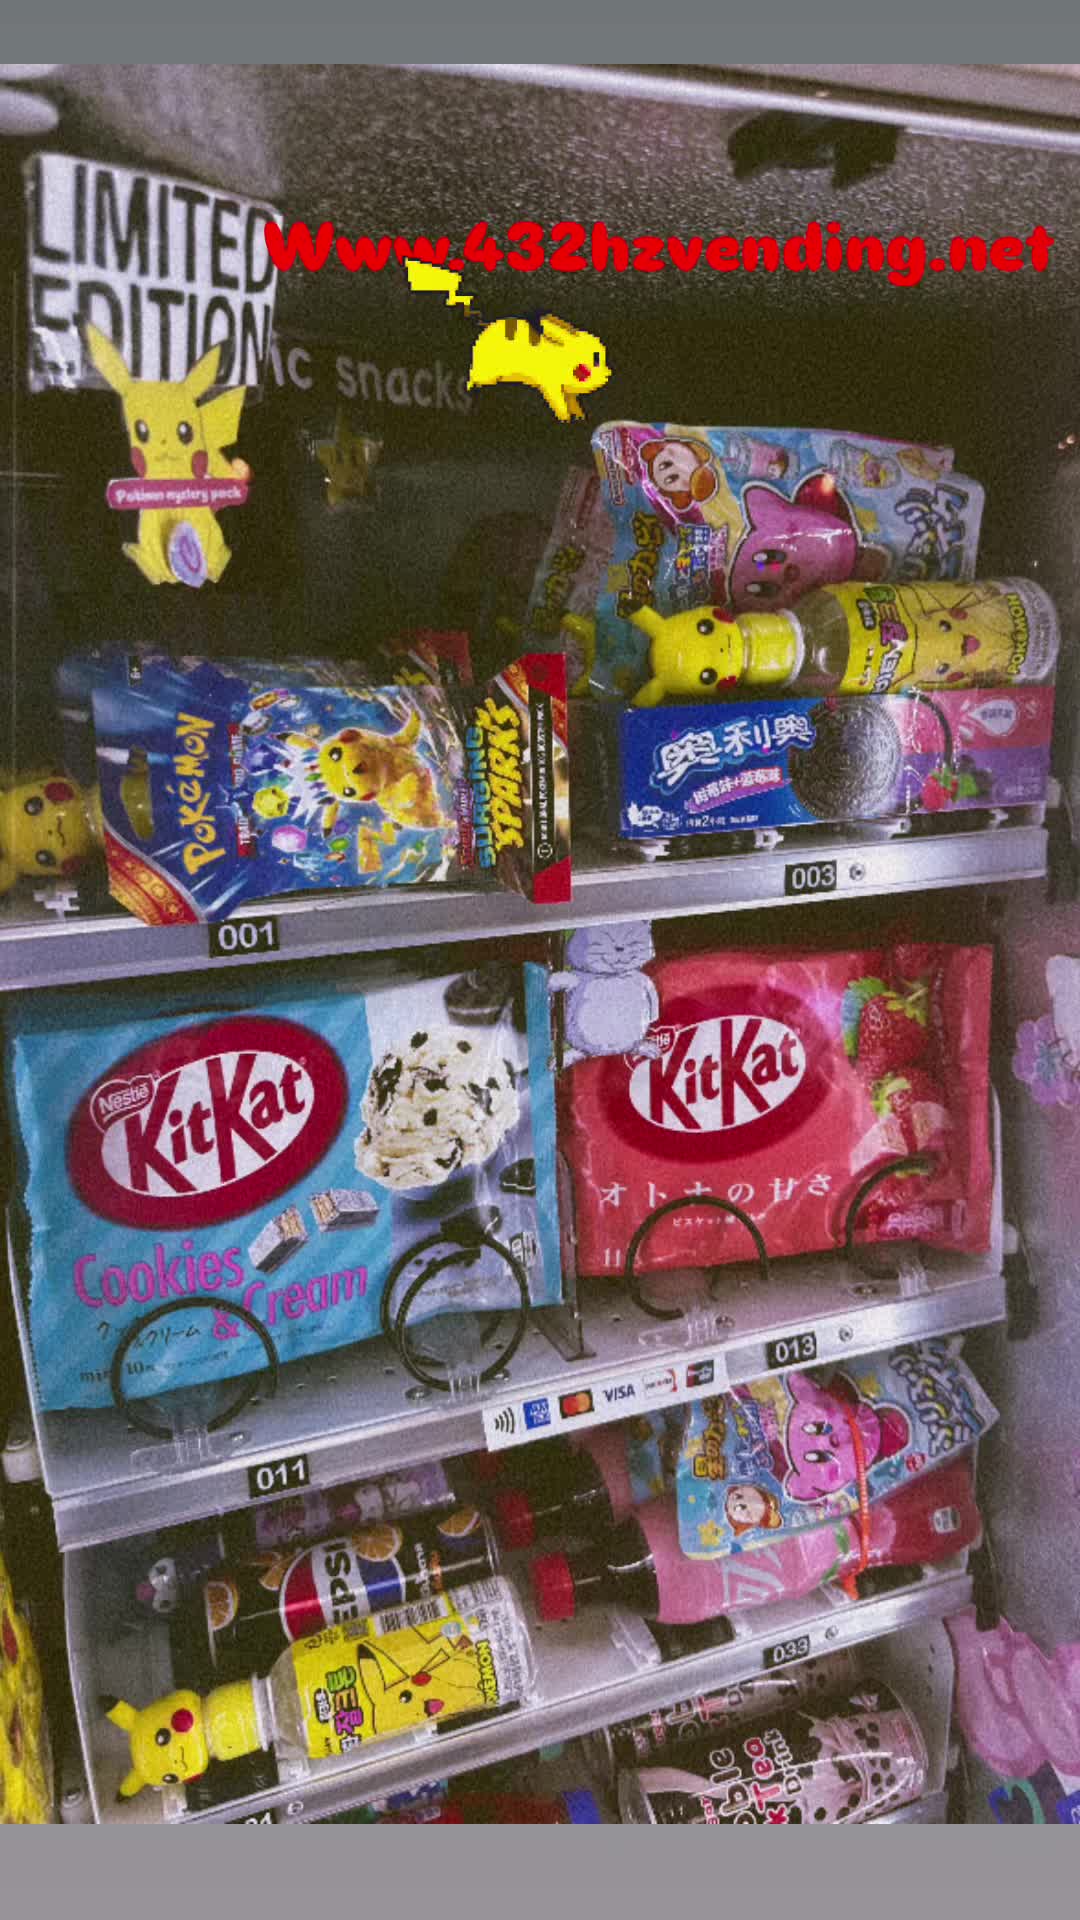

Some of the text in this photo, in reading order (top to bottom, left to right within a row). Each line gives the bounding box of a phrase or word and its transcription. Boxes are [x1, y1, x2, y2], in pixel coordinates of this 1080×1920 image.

[34, 157, 276, 294] LIMITED
[32, 273, 271, 386] EDITION
[475, 697, 525, 851] SPARKS
[659, 713, 814, 785] 奥利奥
[465, 727, 497, 869] SURGING
[790, 865, 836, 889] 003
[218, 922, 275, 950] 001
[100, 1085, 151, 1113] Nestlé
[650, 1018, 800, 1130] KitKat
[123, 1052, 304, 1195] KitKat
[73, 1239, 243, 1308] Cookies
[211, 1304, 239, 1341] &
[242, 1266, 367, 1330] Cream
[774, 1337, 816, 1364] 013
[604, 1382, 637, 1403] VISA
[257, 1461, 305, 1490] 011
[328, 1543, 358, 1624] EPSI
[773, 1639, 809, 1661] 033
[743, 1738, 780, 1812] Tea
[763, 1729, 801, 1796] Drink
